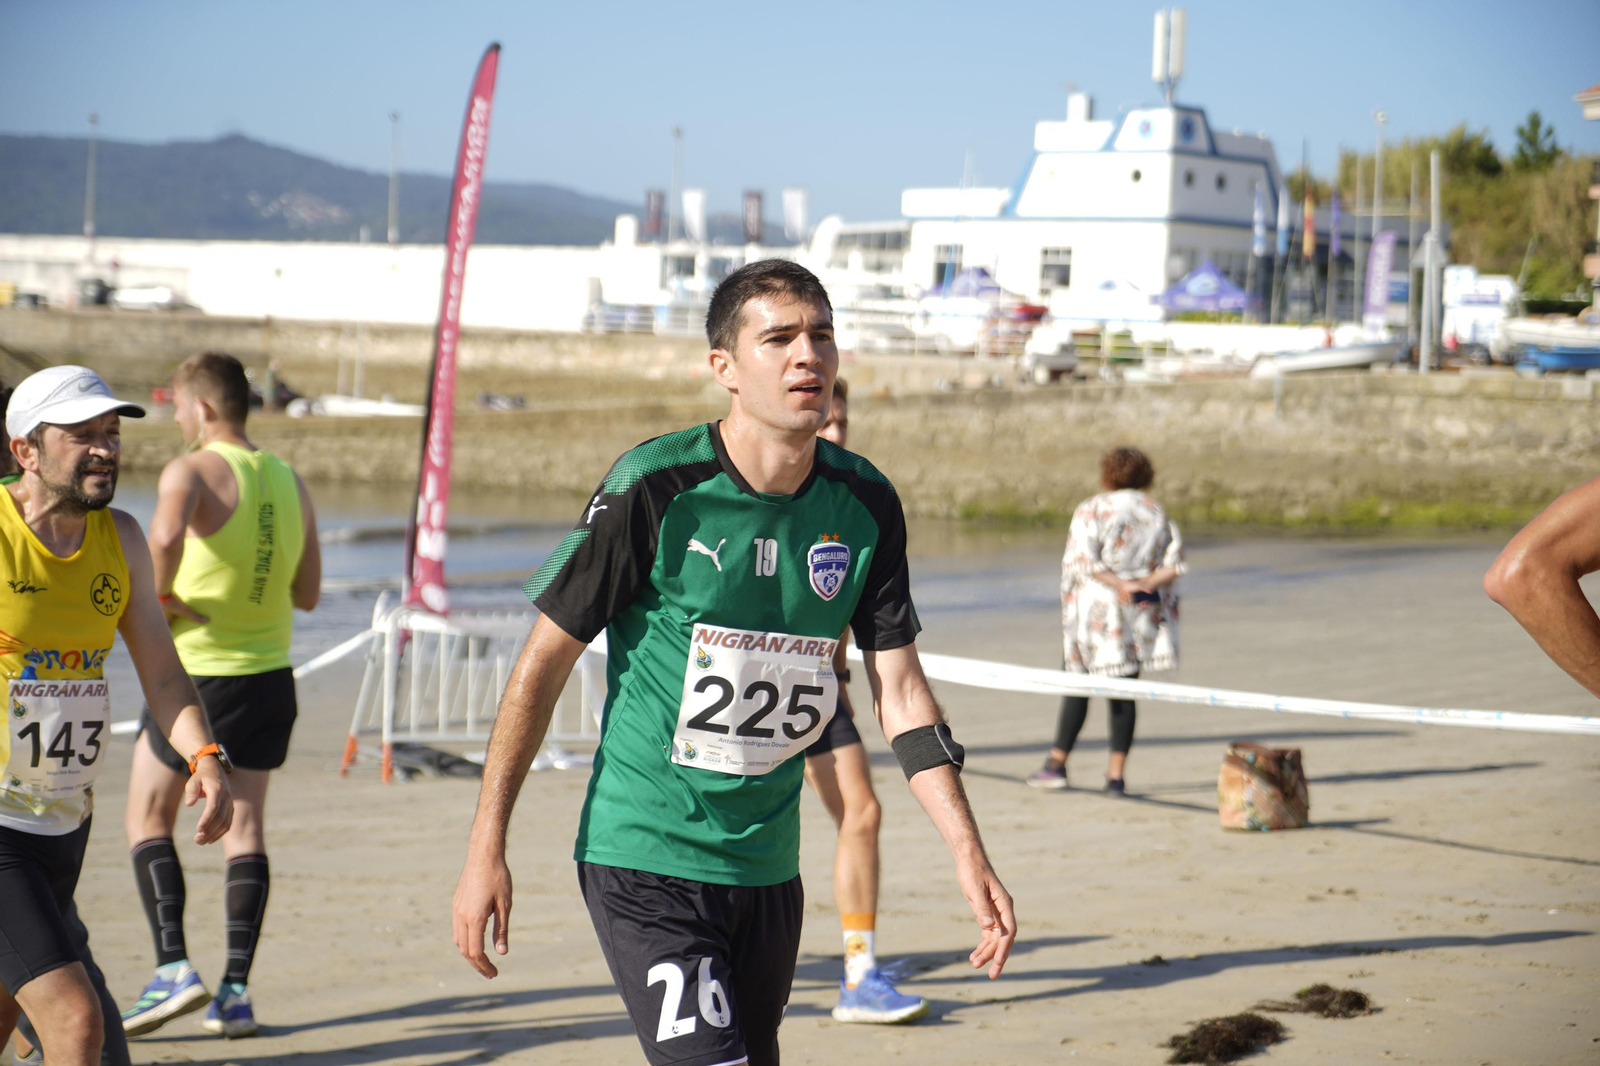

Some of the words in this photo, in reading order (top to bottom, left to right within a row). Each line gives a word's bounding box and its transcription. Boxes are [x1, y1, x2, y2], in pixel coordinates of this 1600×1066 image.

[248, 577, 267, 604] JUAN
[258, 502, 274, 546] SANTOS
[754, 538, 778, 577] 19
[104, 603, 113, 613] 11
[694, 629, 786, 652] NIGRÁN
[786, 640, 835, 657] AREA
[10, 682, 82, 697] NIGRÁN
[686, 675, 823, 740] 225
[17, 721, 104, 768] 143
[718, 737, 742, 746] Antonio
[646, 956, 731, 1042] 26
